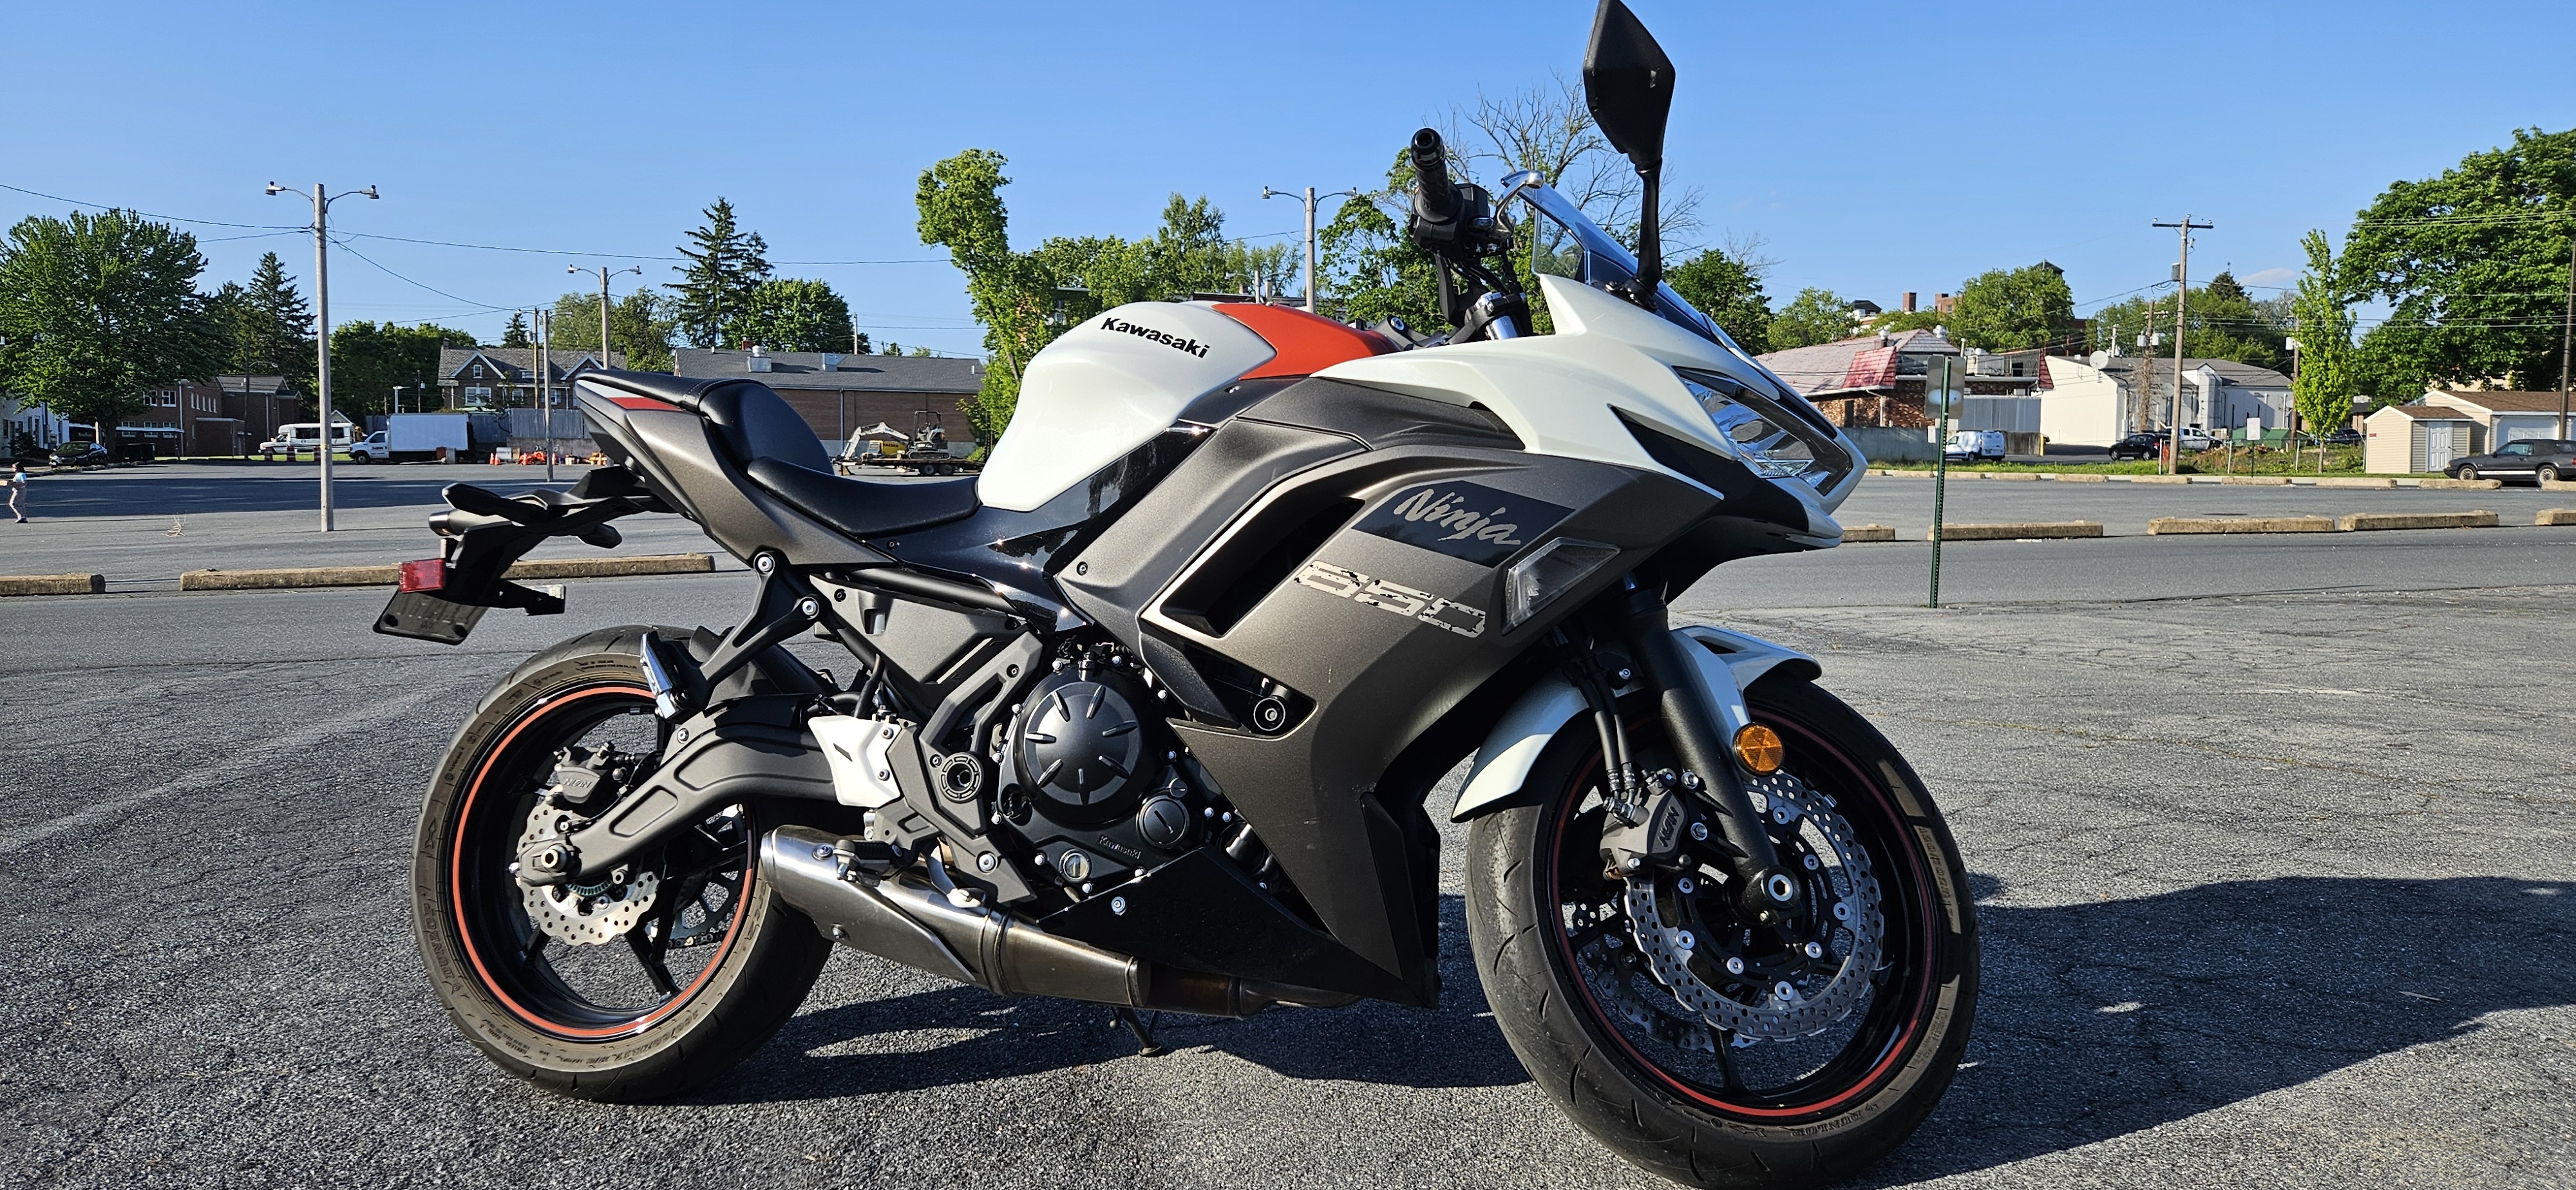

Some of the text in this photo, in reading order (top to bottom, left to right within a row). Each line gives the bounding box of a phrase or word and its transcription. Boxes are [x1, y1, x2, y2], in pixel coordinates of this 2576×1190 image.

[1100, 317, 1211, 360] Kawasaki
[1392, 487, 1522, 547] Ninja
[1294, 560, 1487, 639] 650
[1099, 834, 1142, 860] Kawasaki
[1790, 1110, 1863, 1137] DUNLOP
